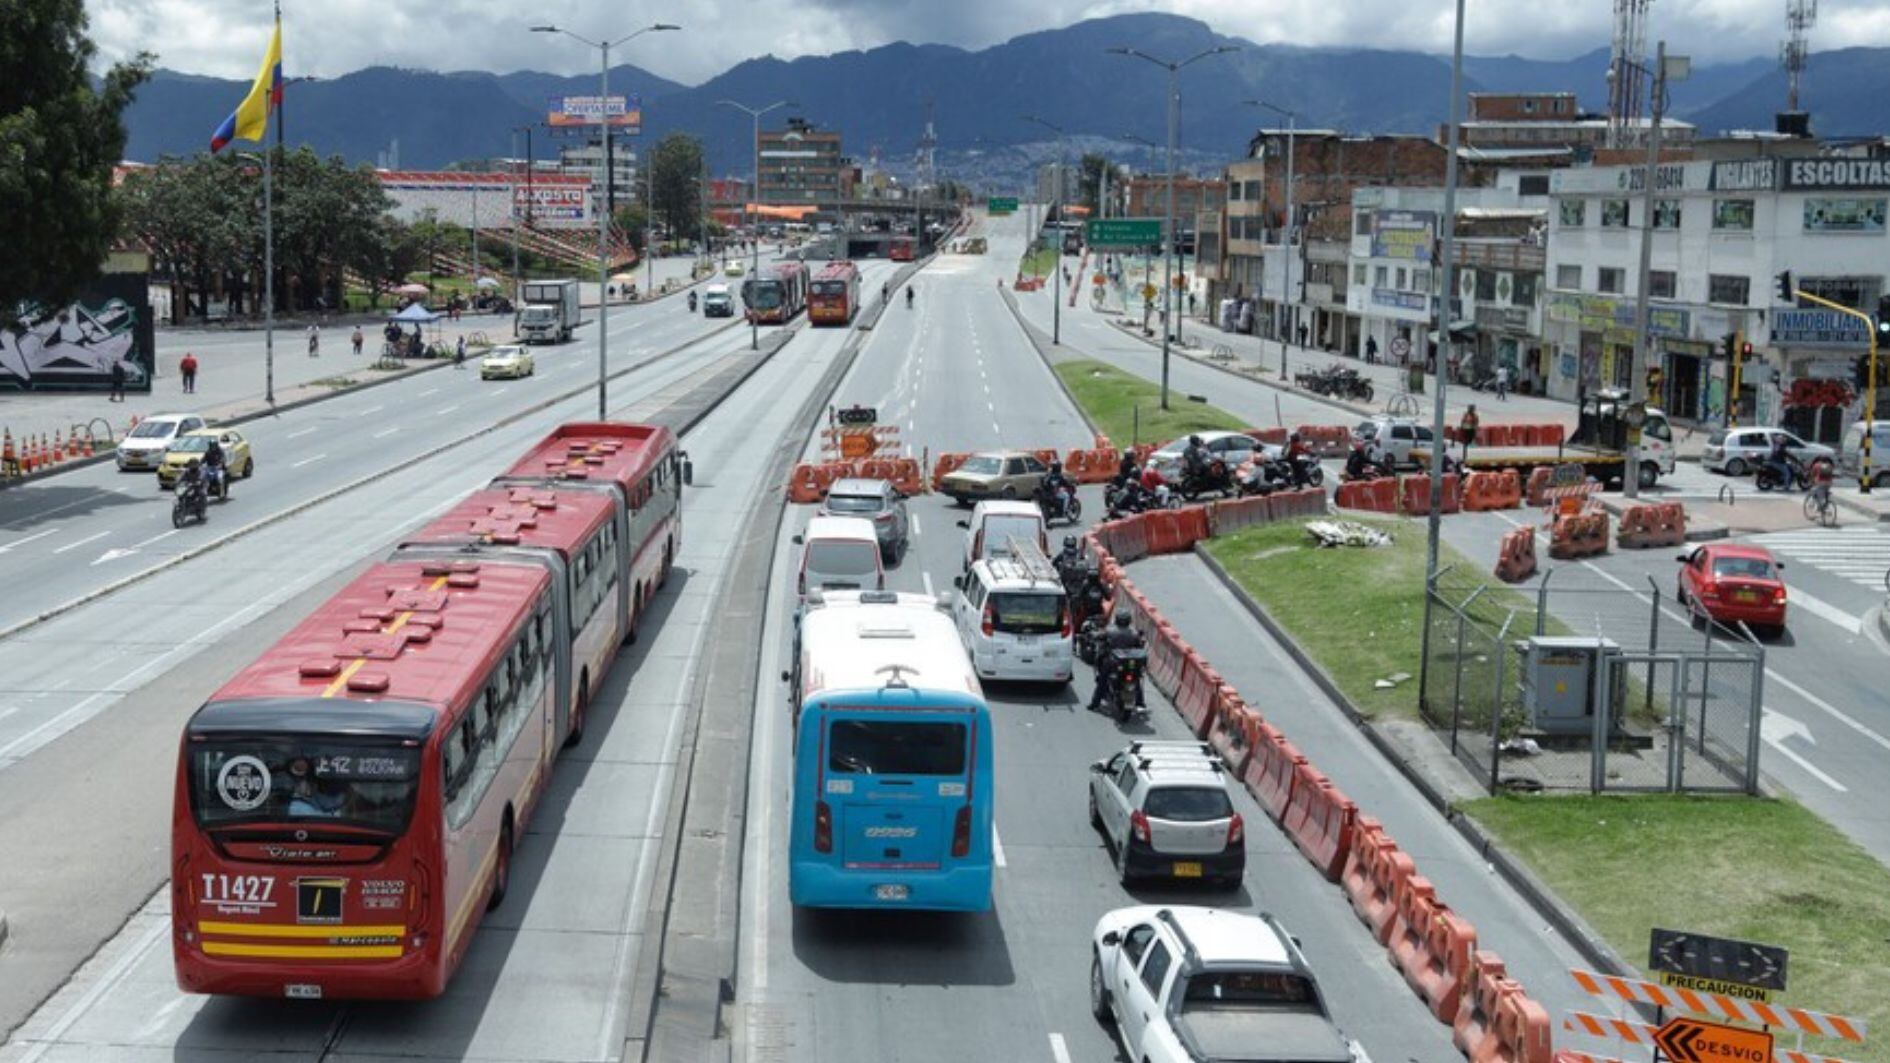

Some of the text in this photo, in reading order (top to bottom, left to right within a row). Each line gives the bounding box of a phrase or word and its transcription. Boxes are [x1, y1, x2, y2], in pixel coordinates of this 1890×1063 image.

[202, 873, 276, 901] T1427
[1666, 973, 1766, 1002] PRECAUCION
[1695, 1038, 1764, 1063] DESVIO
